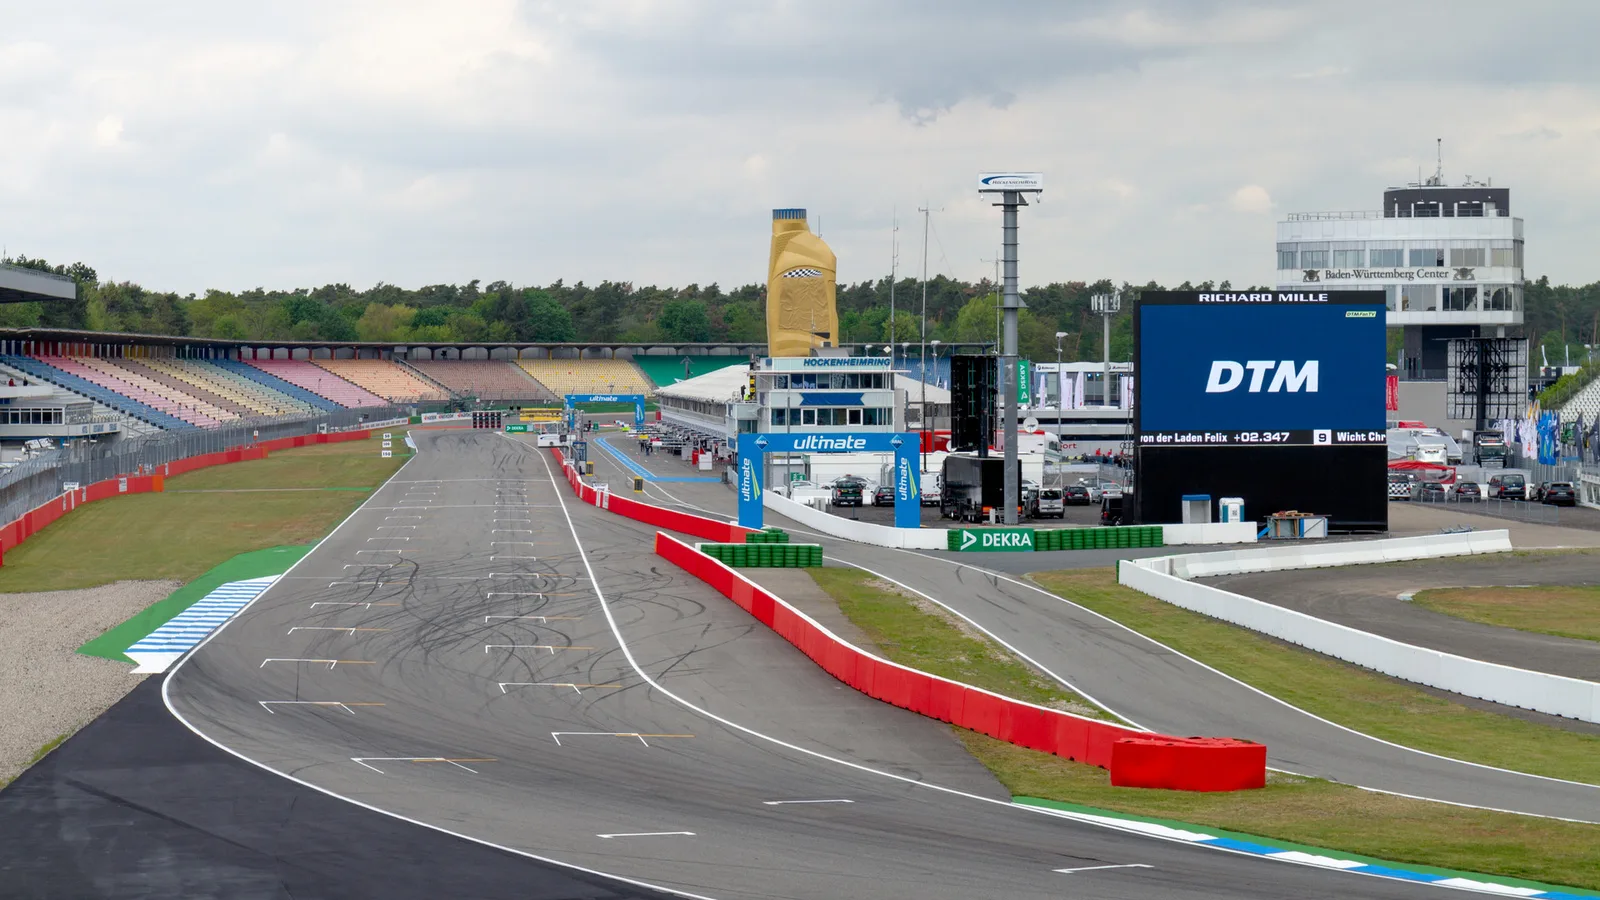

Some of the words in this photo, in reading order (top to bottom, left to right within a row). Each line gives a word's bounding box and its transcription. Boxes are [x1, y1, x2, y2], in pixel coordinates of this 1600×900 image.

[1325, 269, 1414, 281] Baden-Württemberg
[1416, 268, 1449, 278] Center
[1200, 293, 1272, 302] RICHARD
[1278, 293, 1328, 302] MILLE
[803, 358, 891, 367] HOCKENHEIMRING
[1205, 360, 1319, 393] DTM
[793, 435, 866, 450] ultimate
[1156, 432, 1173, 443] der
[1174, 432, 1203, 443] Laden
[1204, 432, 1228, 443] Felix
[1233, 432, 1290, 442] +02.347
[1318, 433, 1327, 442] 9
[1336, 432, 1367, 442] Wicht
[1368, 431, 1386, 442] Chr
[982, 532, 1032, 547] DEKRA
